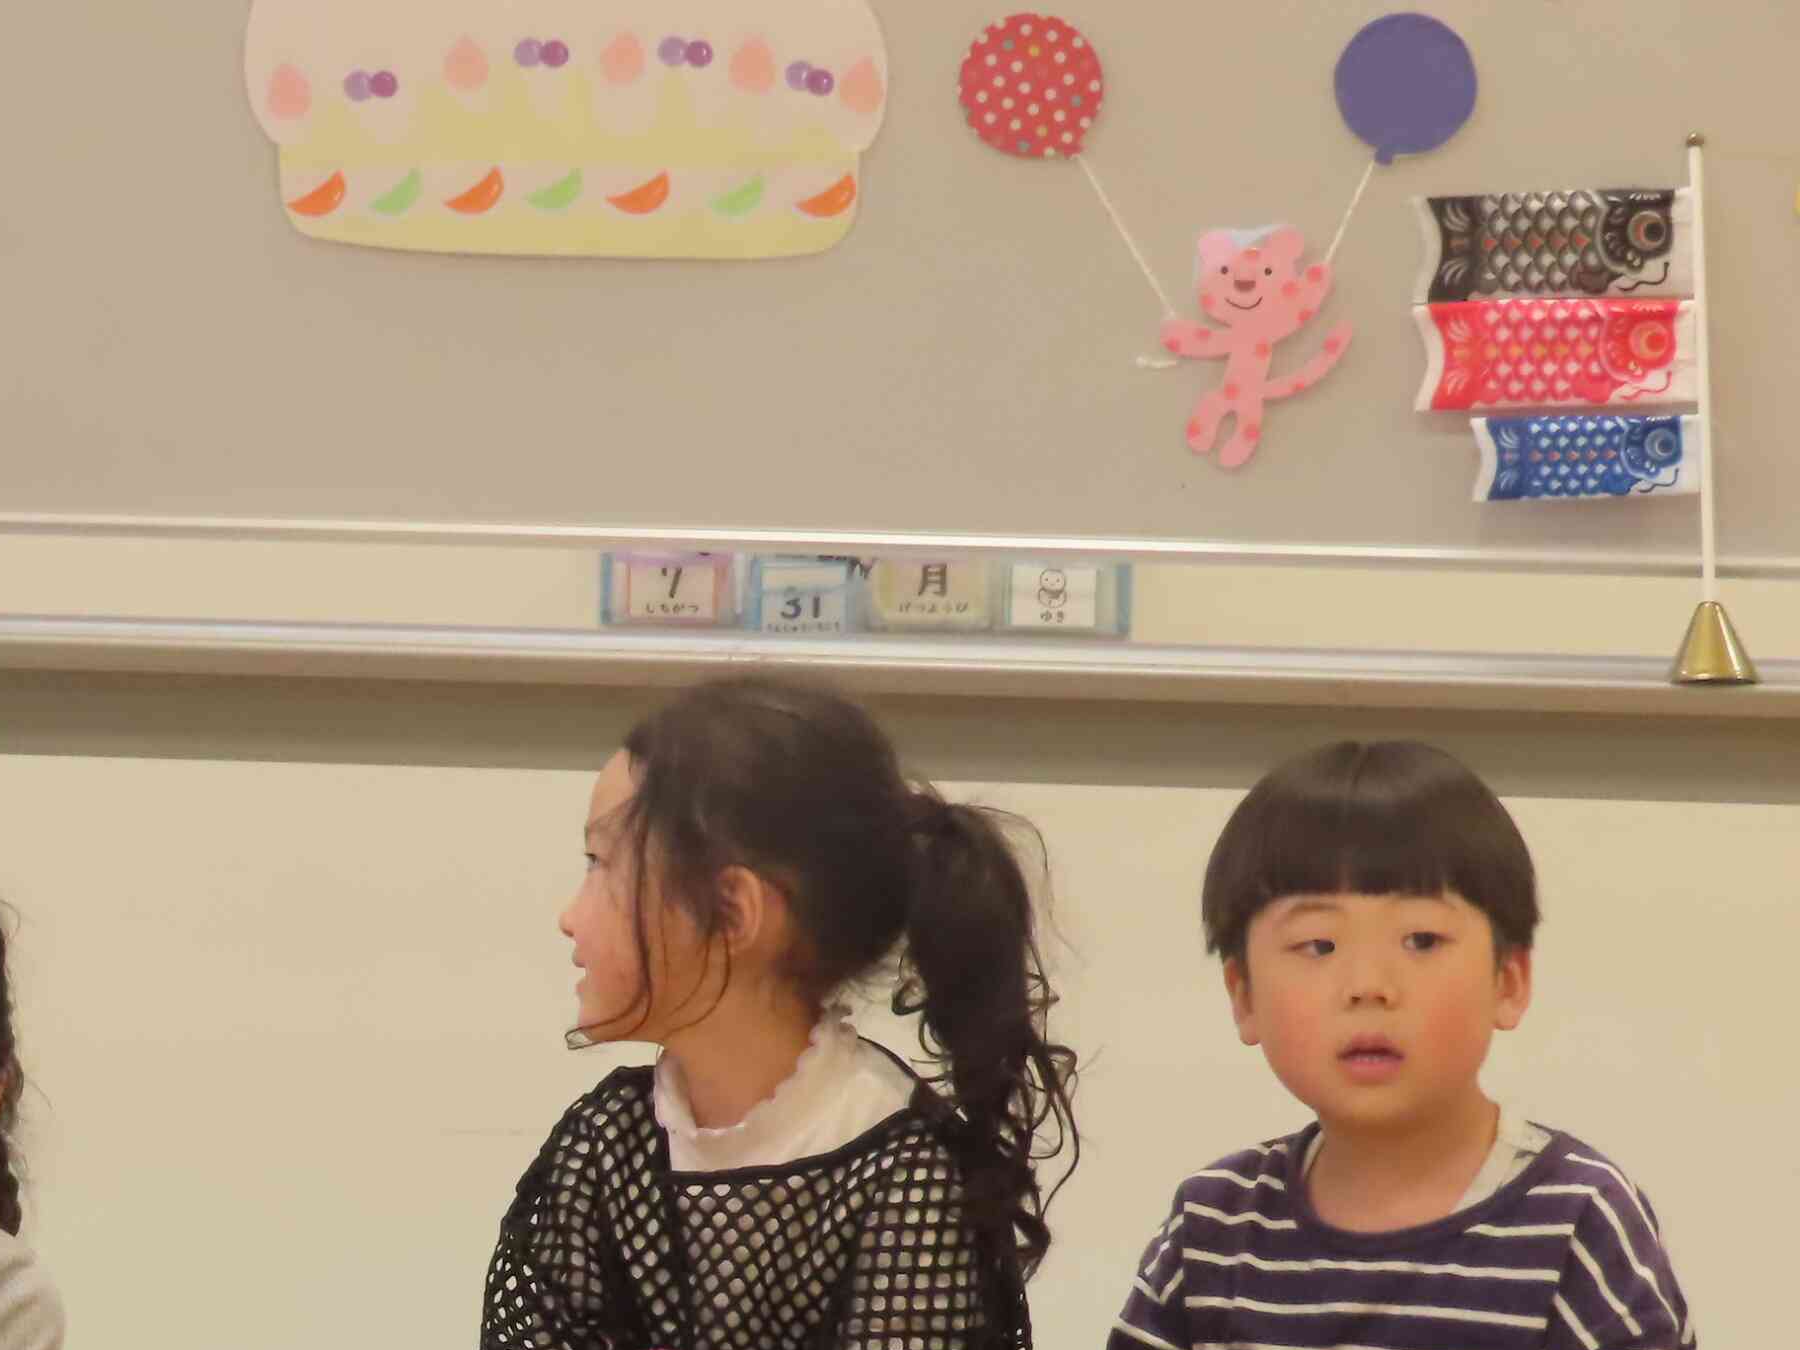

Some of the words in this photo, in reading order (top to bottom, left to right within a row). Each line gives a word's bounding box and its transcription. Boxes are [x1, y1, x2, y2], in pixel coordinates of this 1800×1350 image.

[660, 566, 683, 599] 7
[917, 562, 948, 597] 月
[645, 601, 700, 615] しちがつ
[780, 594, 822, 620] 31
[1039, 610, 1066, 624] ゆき
